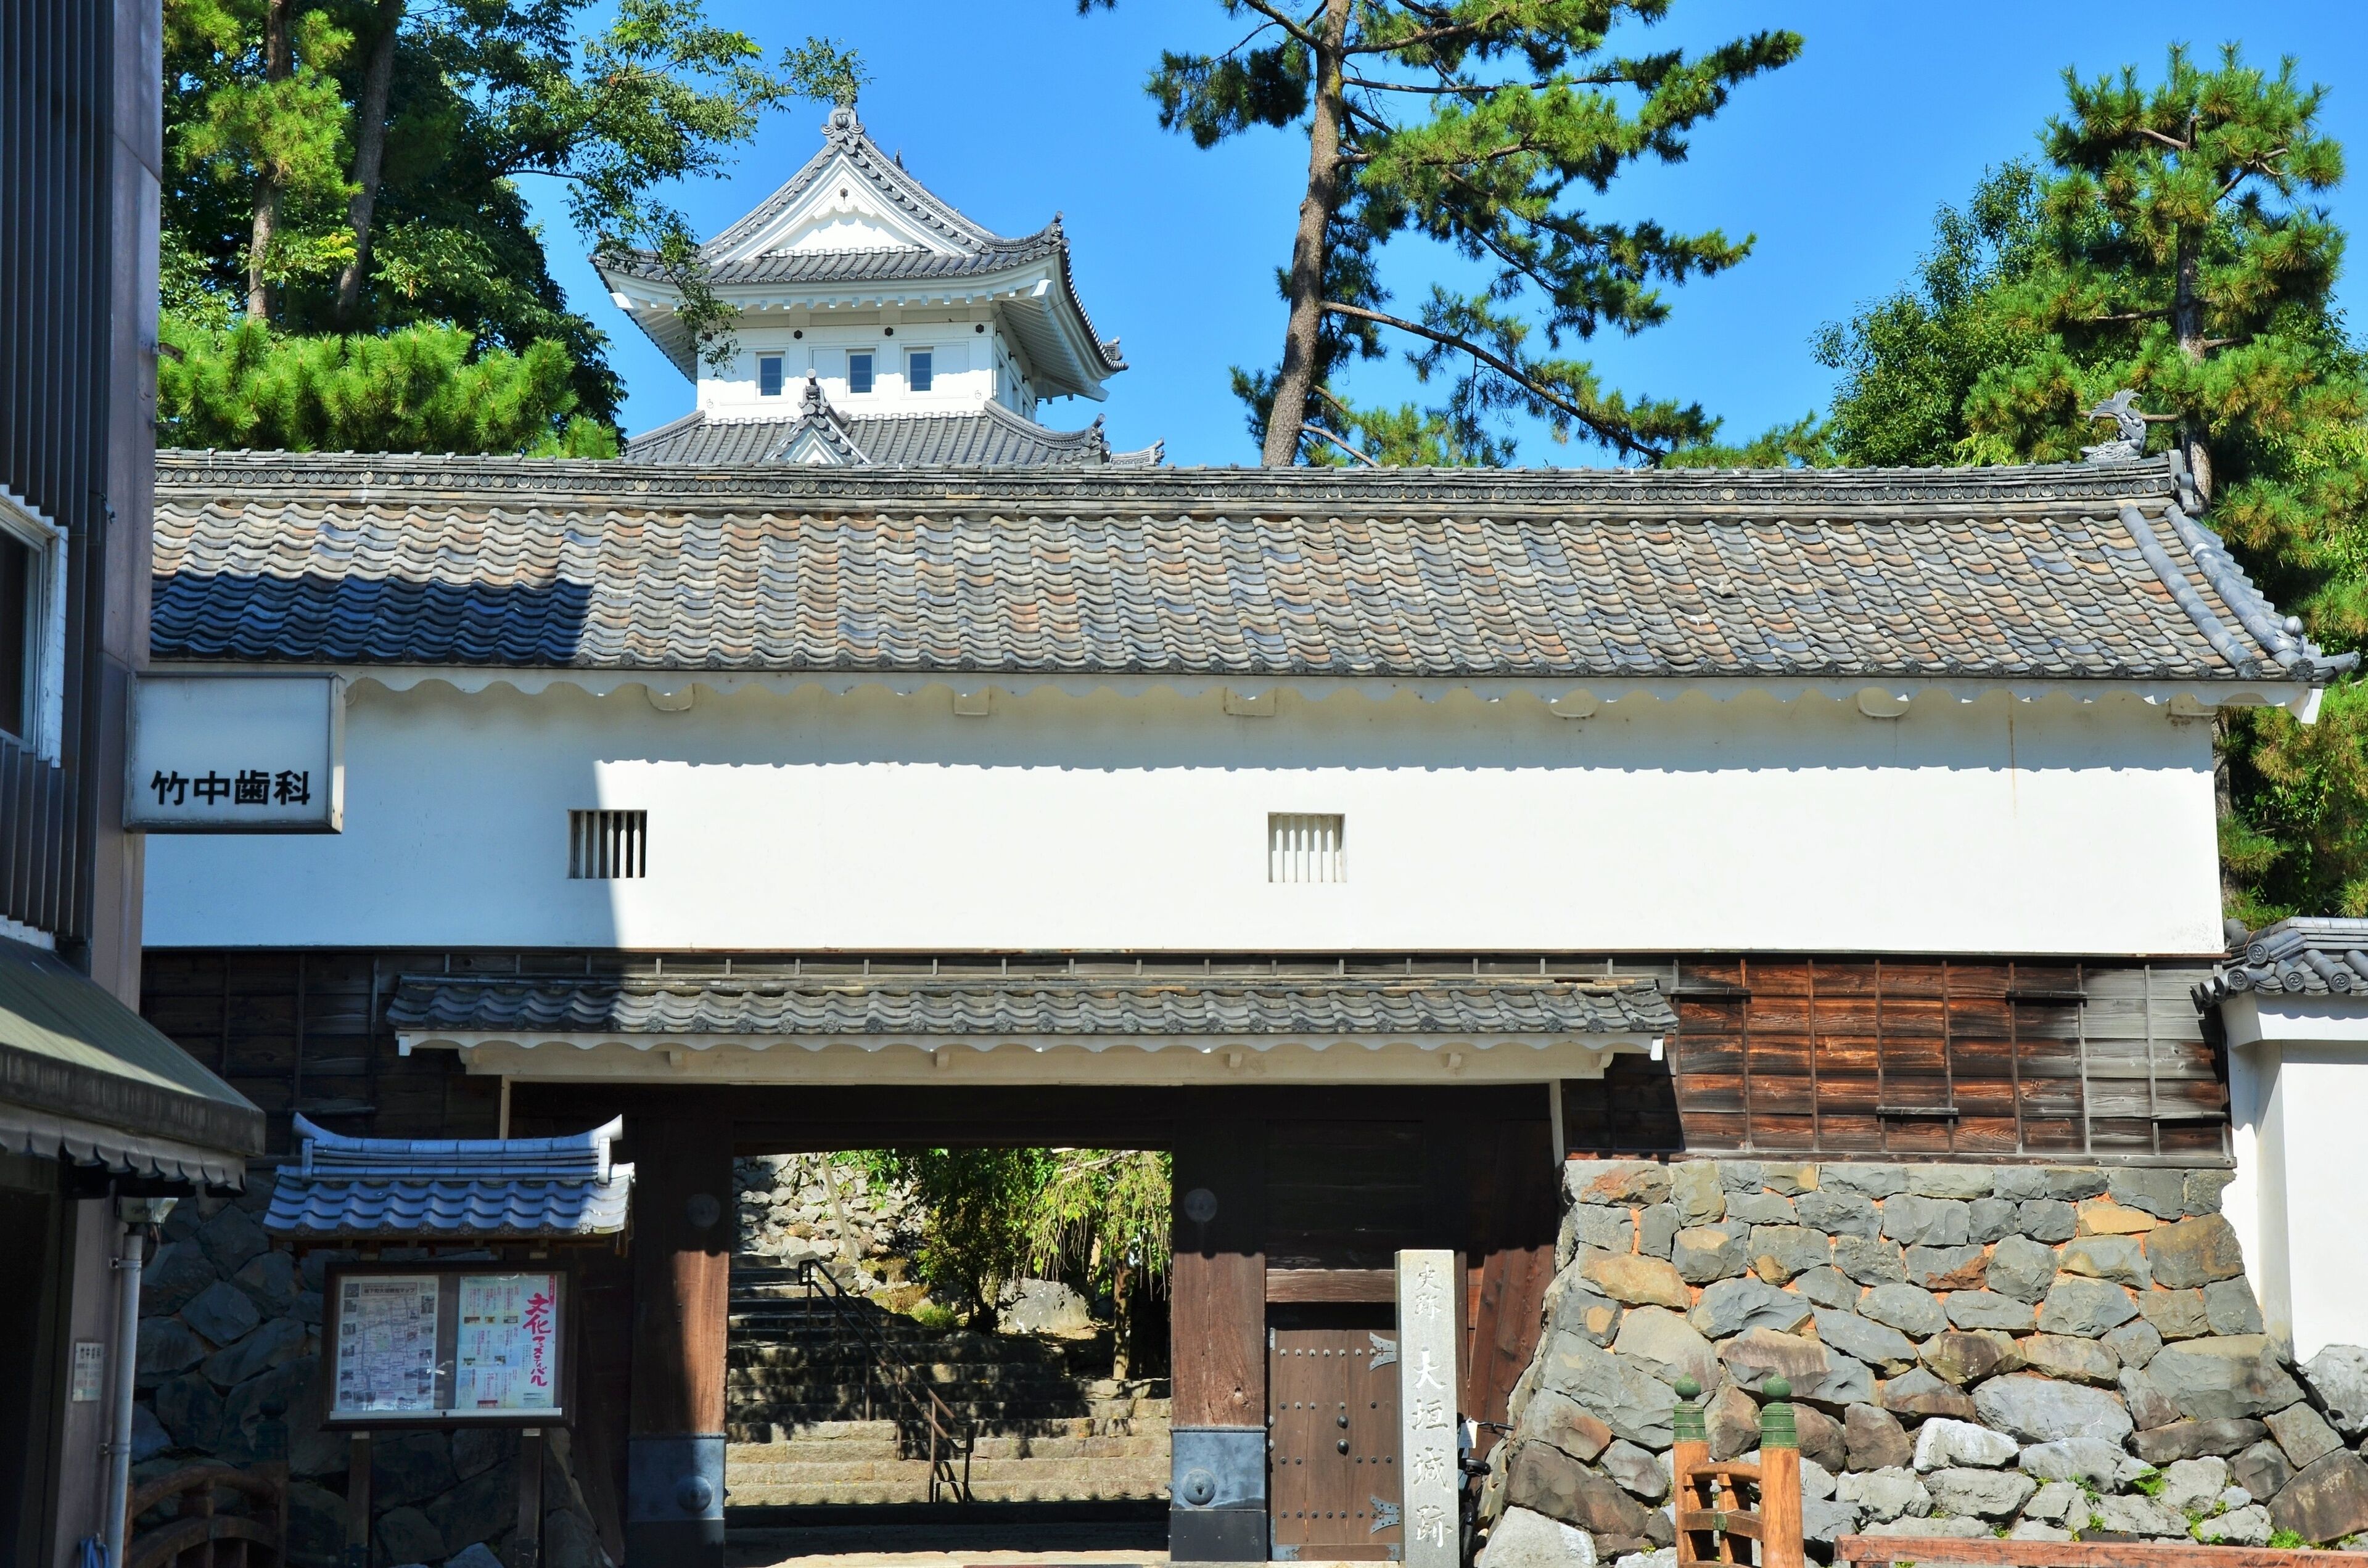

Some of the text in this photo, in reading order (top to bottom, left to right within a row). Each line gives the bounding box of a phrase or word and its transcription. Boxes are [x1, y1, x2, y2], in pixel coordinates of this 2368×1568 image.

[150, 769, 311, 806] 竹中歯科
[522, 1292, 551, 1387] 文化フェスティバル
